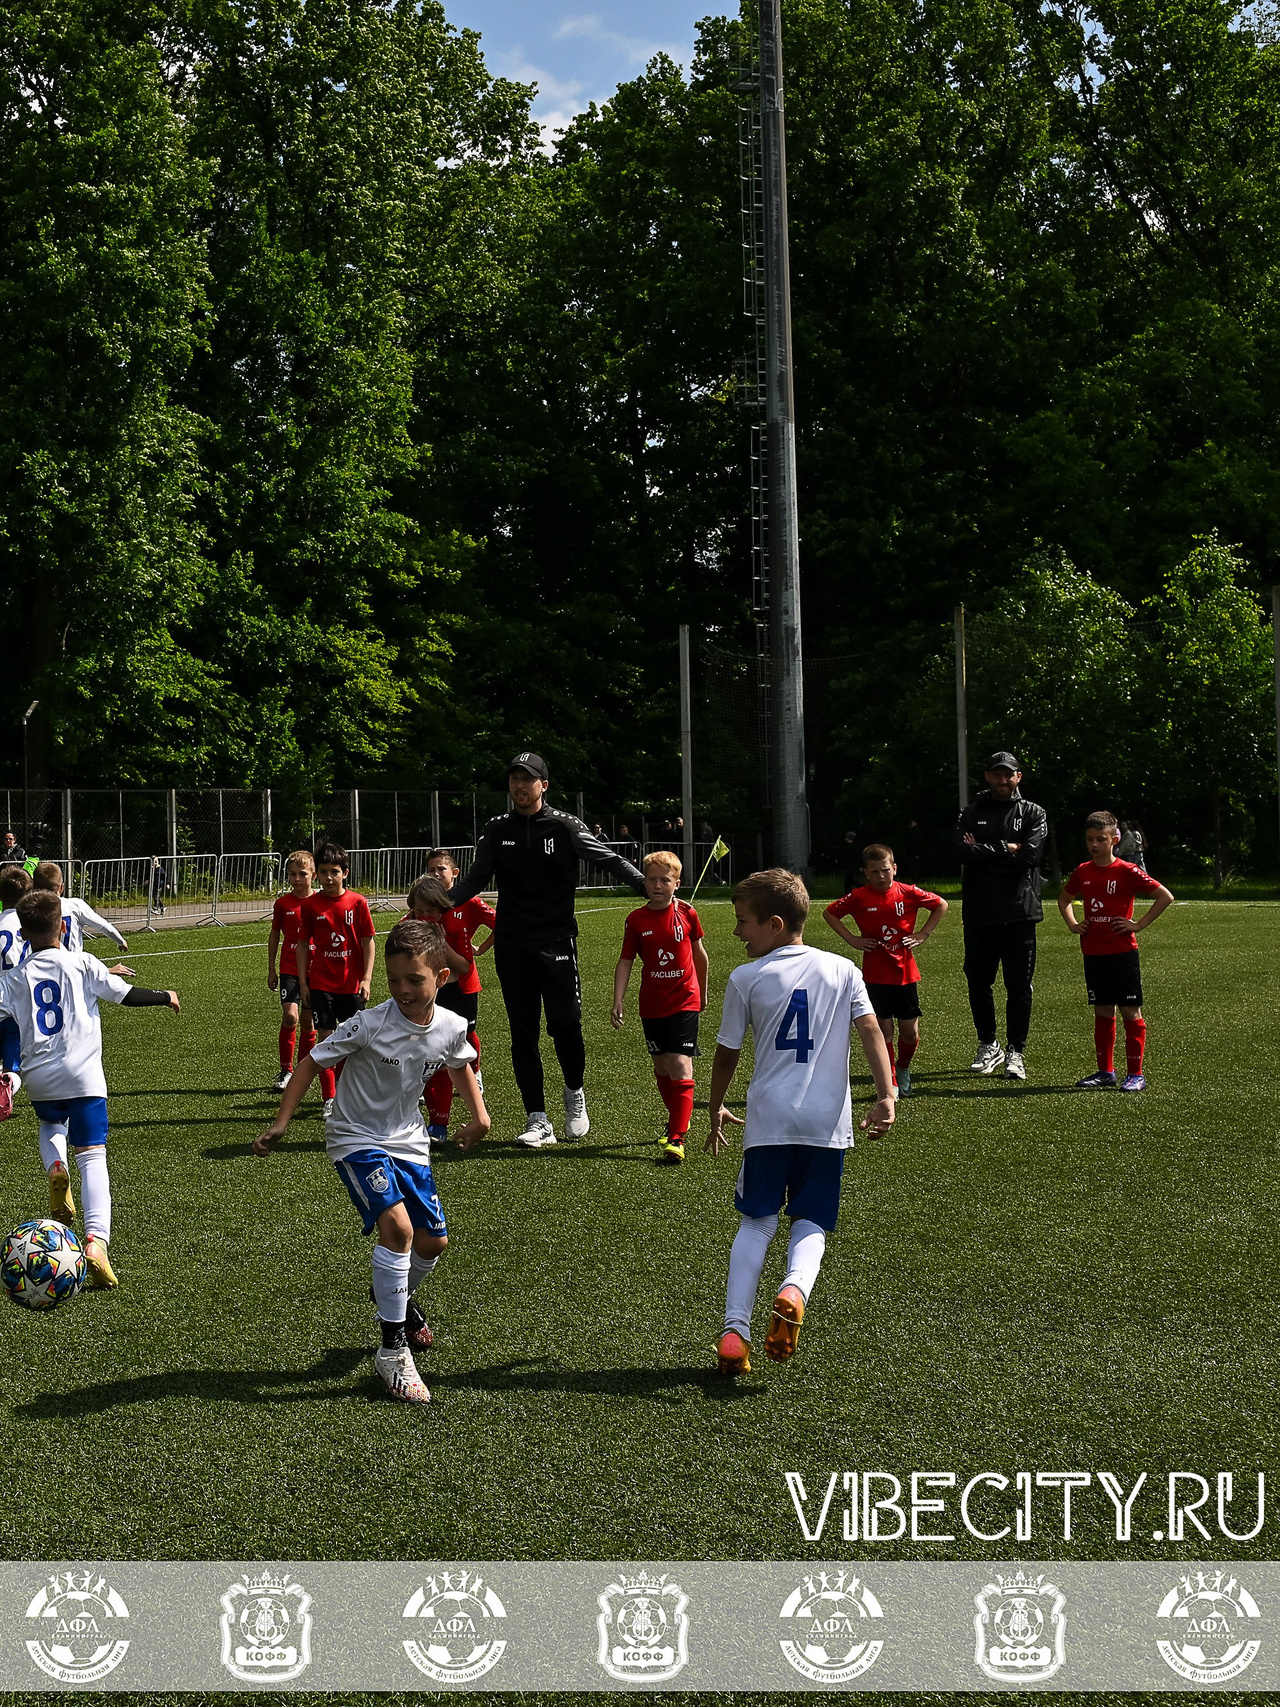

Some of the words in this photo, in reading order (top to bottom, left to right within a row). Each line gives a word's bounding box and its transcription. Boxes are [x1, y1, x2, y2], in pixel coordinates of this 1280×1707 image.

[650, 969, 685, 978] РАСЦВЕТ
[281, 988, 288, 1000] 9
[33, 979, 64, 1036] 8
[775, 988, 815, 1064] 4
[381, 1057, 400, 1066] JAKO
[430, 1193, 442, 1222] 7
